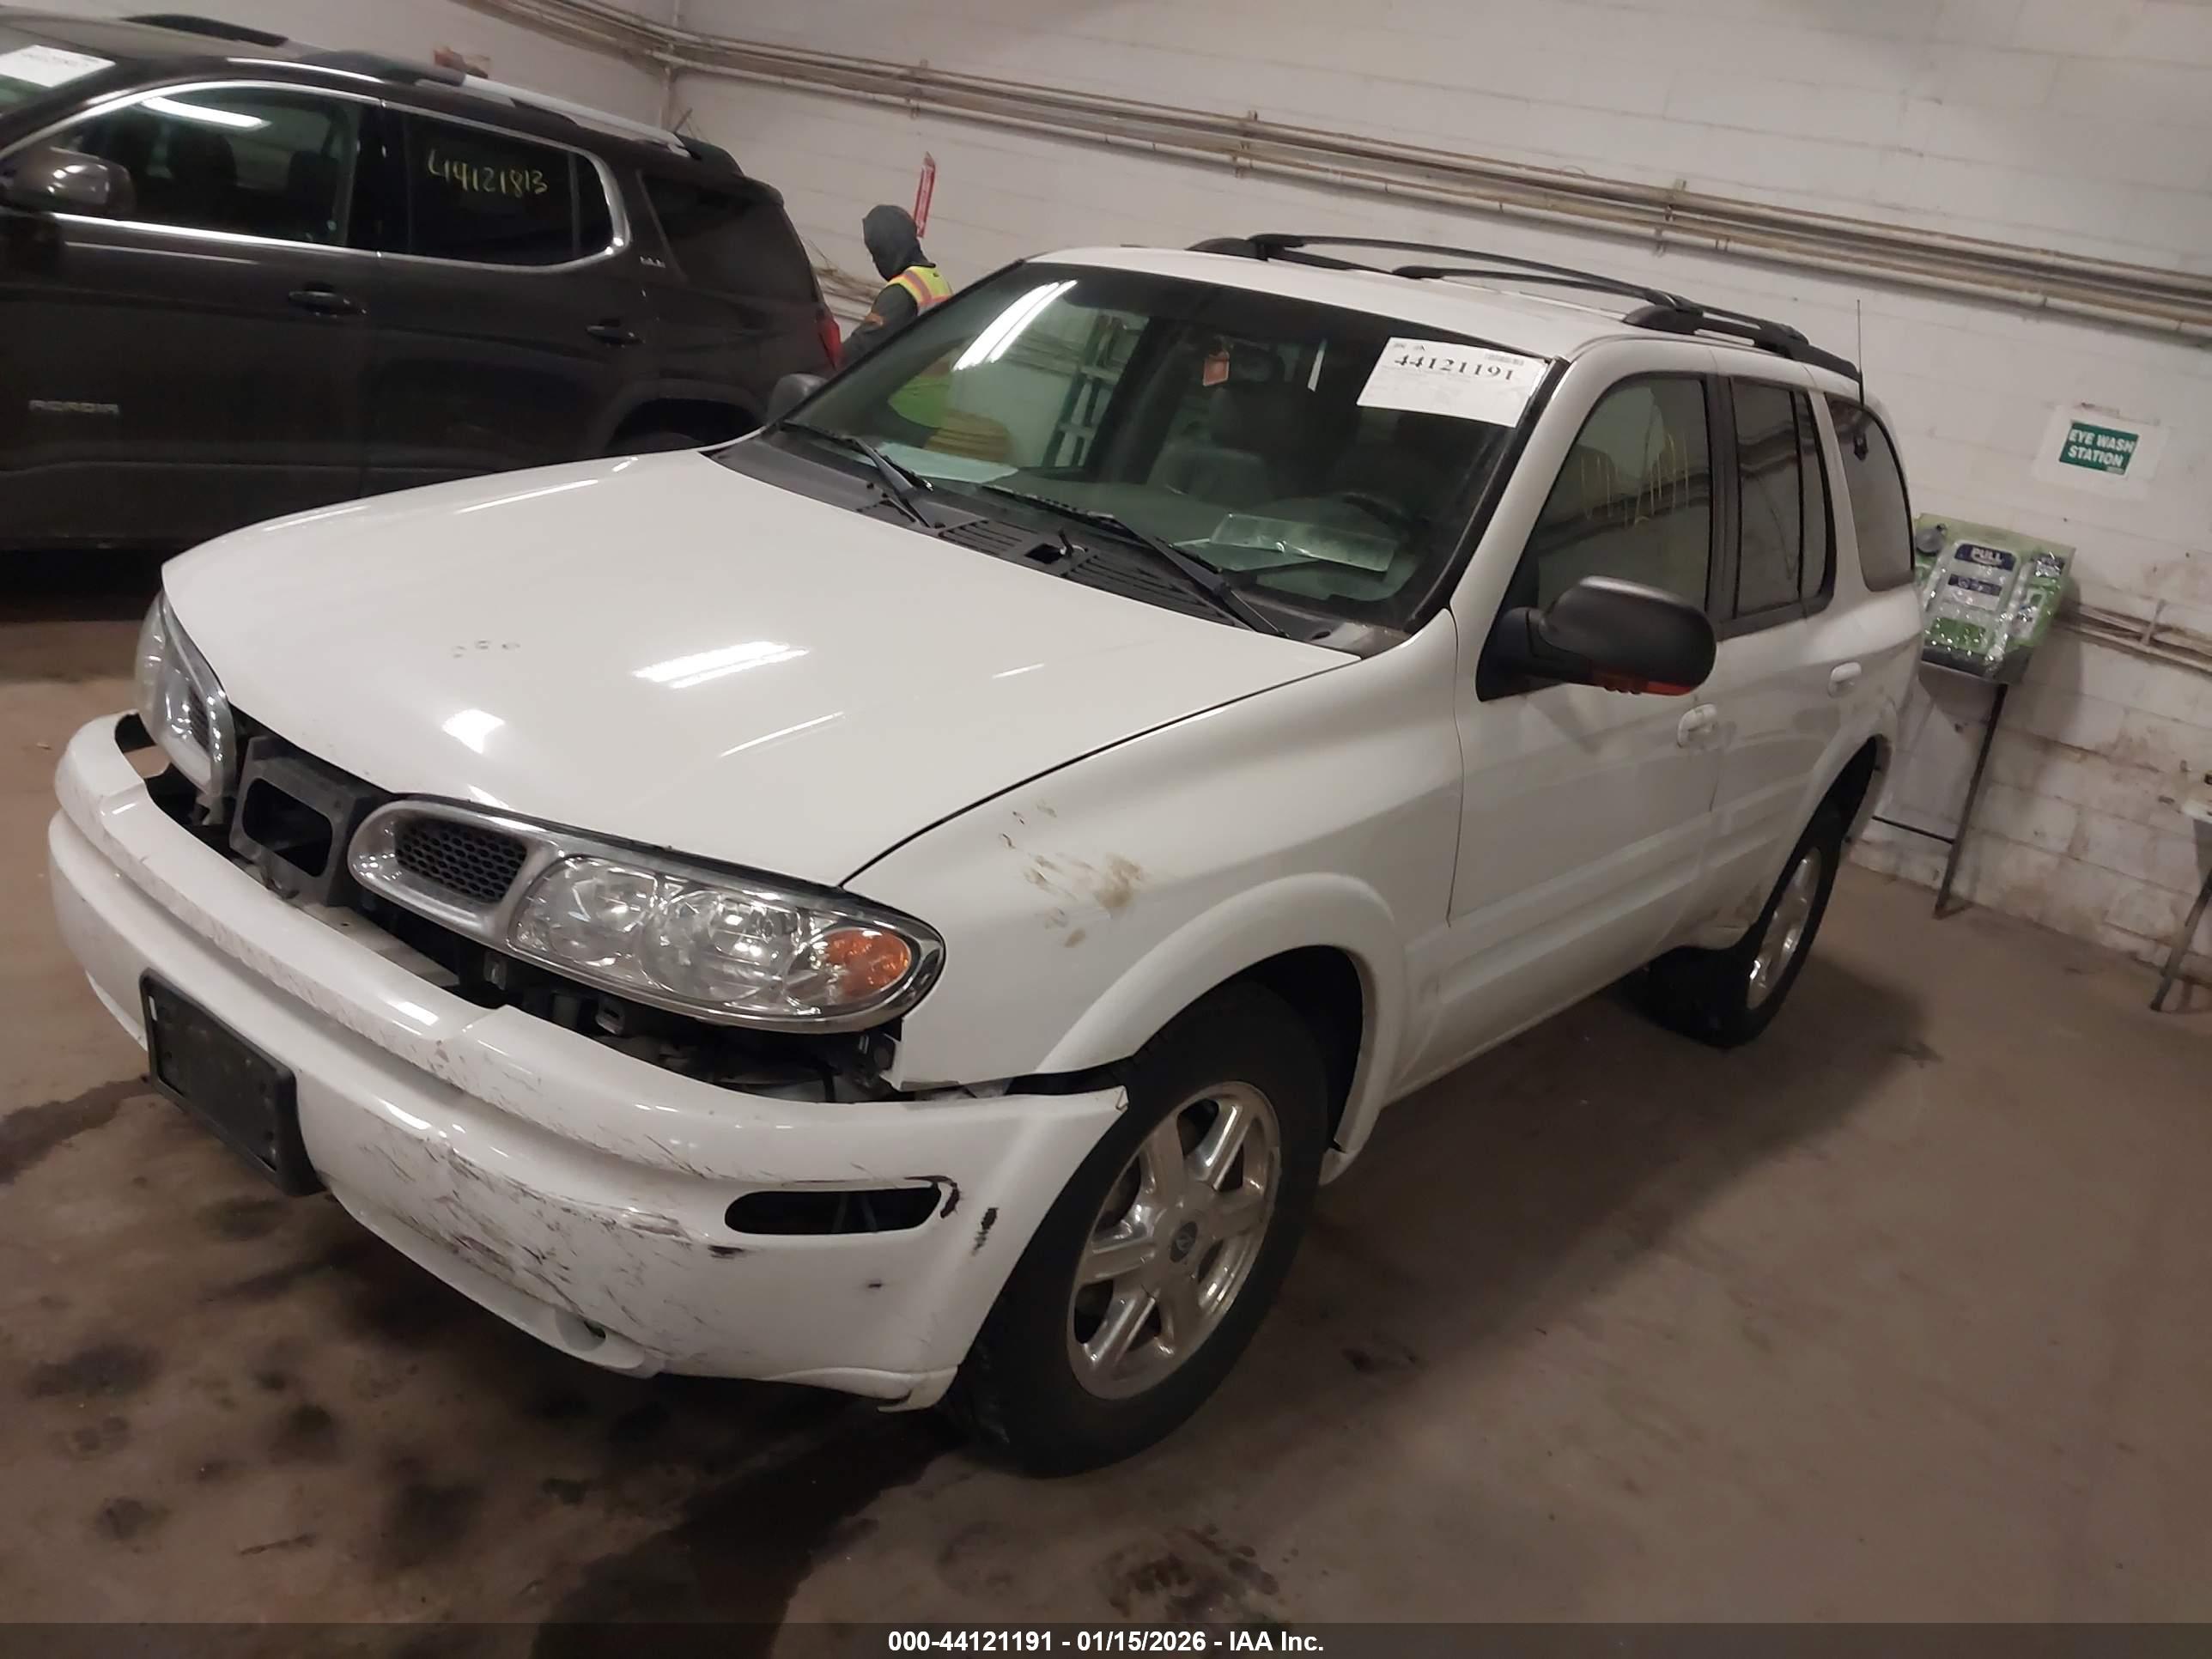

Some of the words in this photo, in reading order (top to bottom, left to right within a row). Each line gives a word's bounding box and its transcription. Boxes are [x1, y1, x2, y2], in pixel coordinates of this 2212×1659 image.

[428, 149, 548, 198] 44121813
[1395, 355, 1513, 380] 44121191
[2069, 429, 2095, 445] EYE
[2097, 434, 2135, 453] WASH
[2068, 445, 2124, 467] STATION
